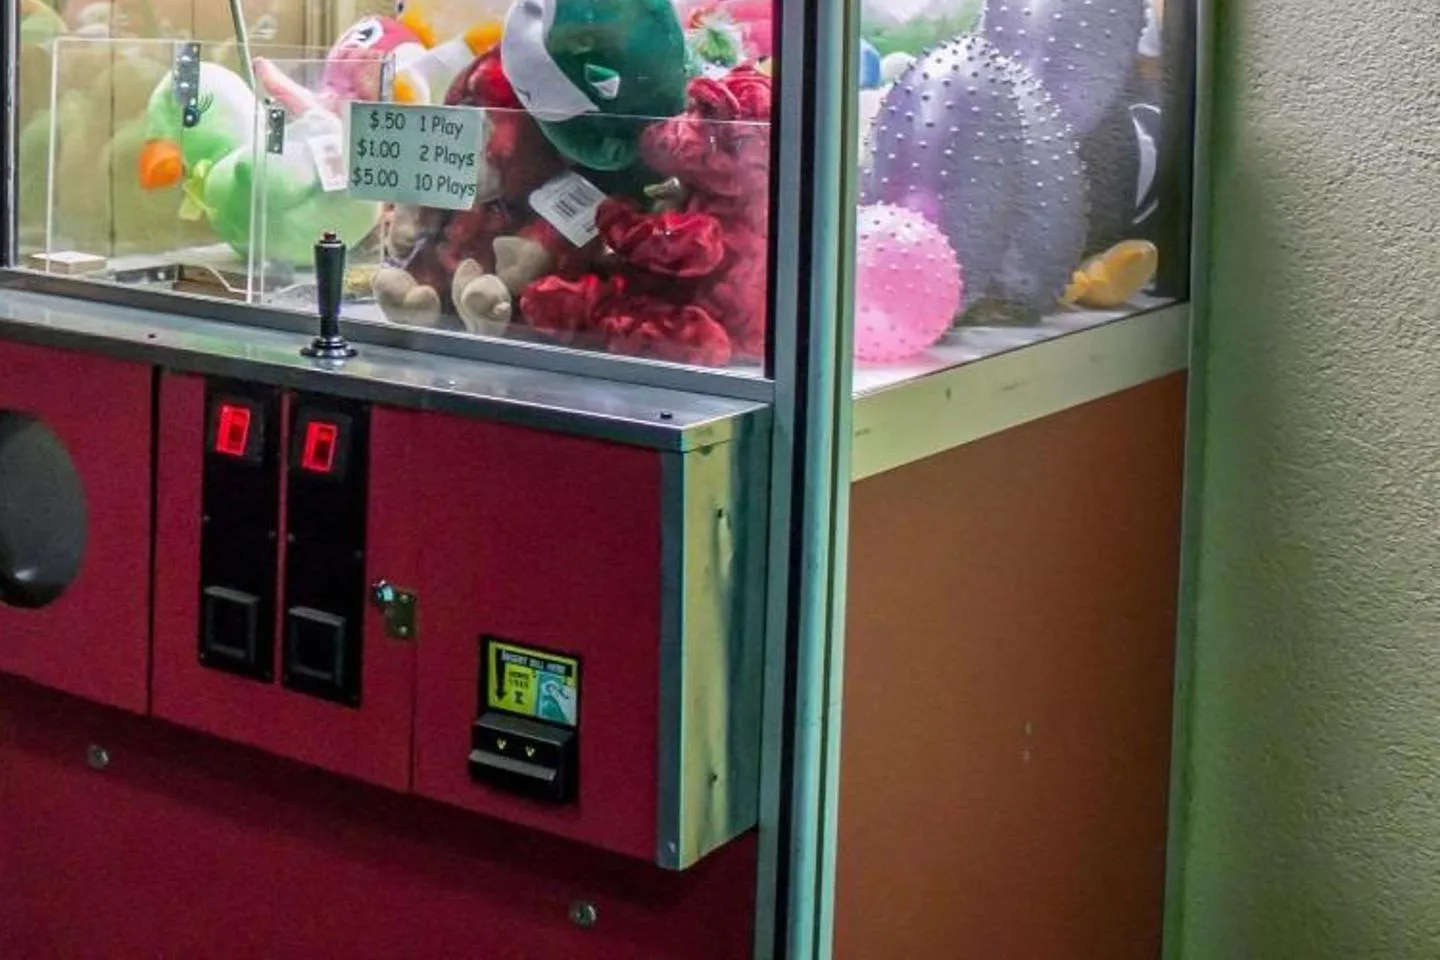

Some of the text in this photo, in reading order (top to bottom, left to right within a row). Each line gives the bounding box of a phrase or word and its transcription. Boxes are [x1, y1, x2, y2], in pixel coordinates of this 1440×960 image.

[370, 111, 464, 140] $.50 1 Play
[357, 139, 475, 167] $1.00 2 Plays
[352, 167, 477, 197] $5.00 10 Plays
